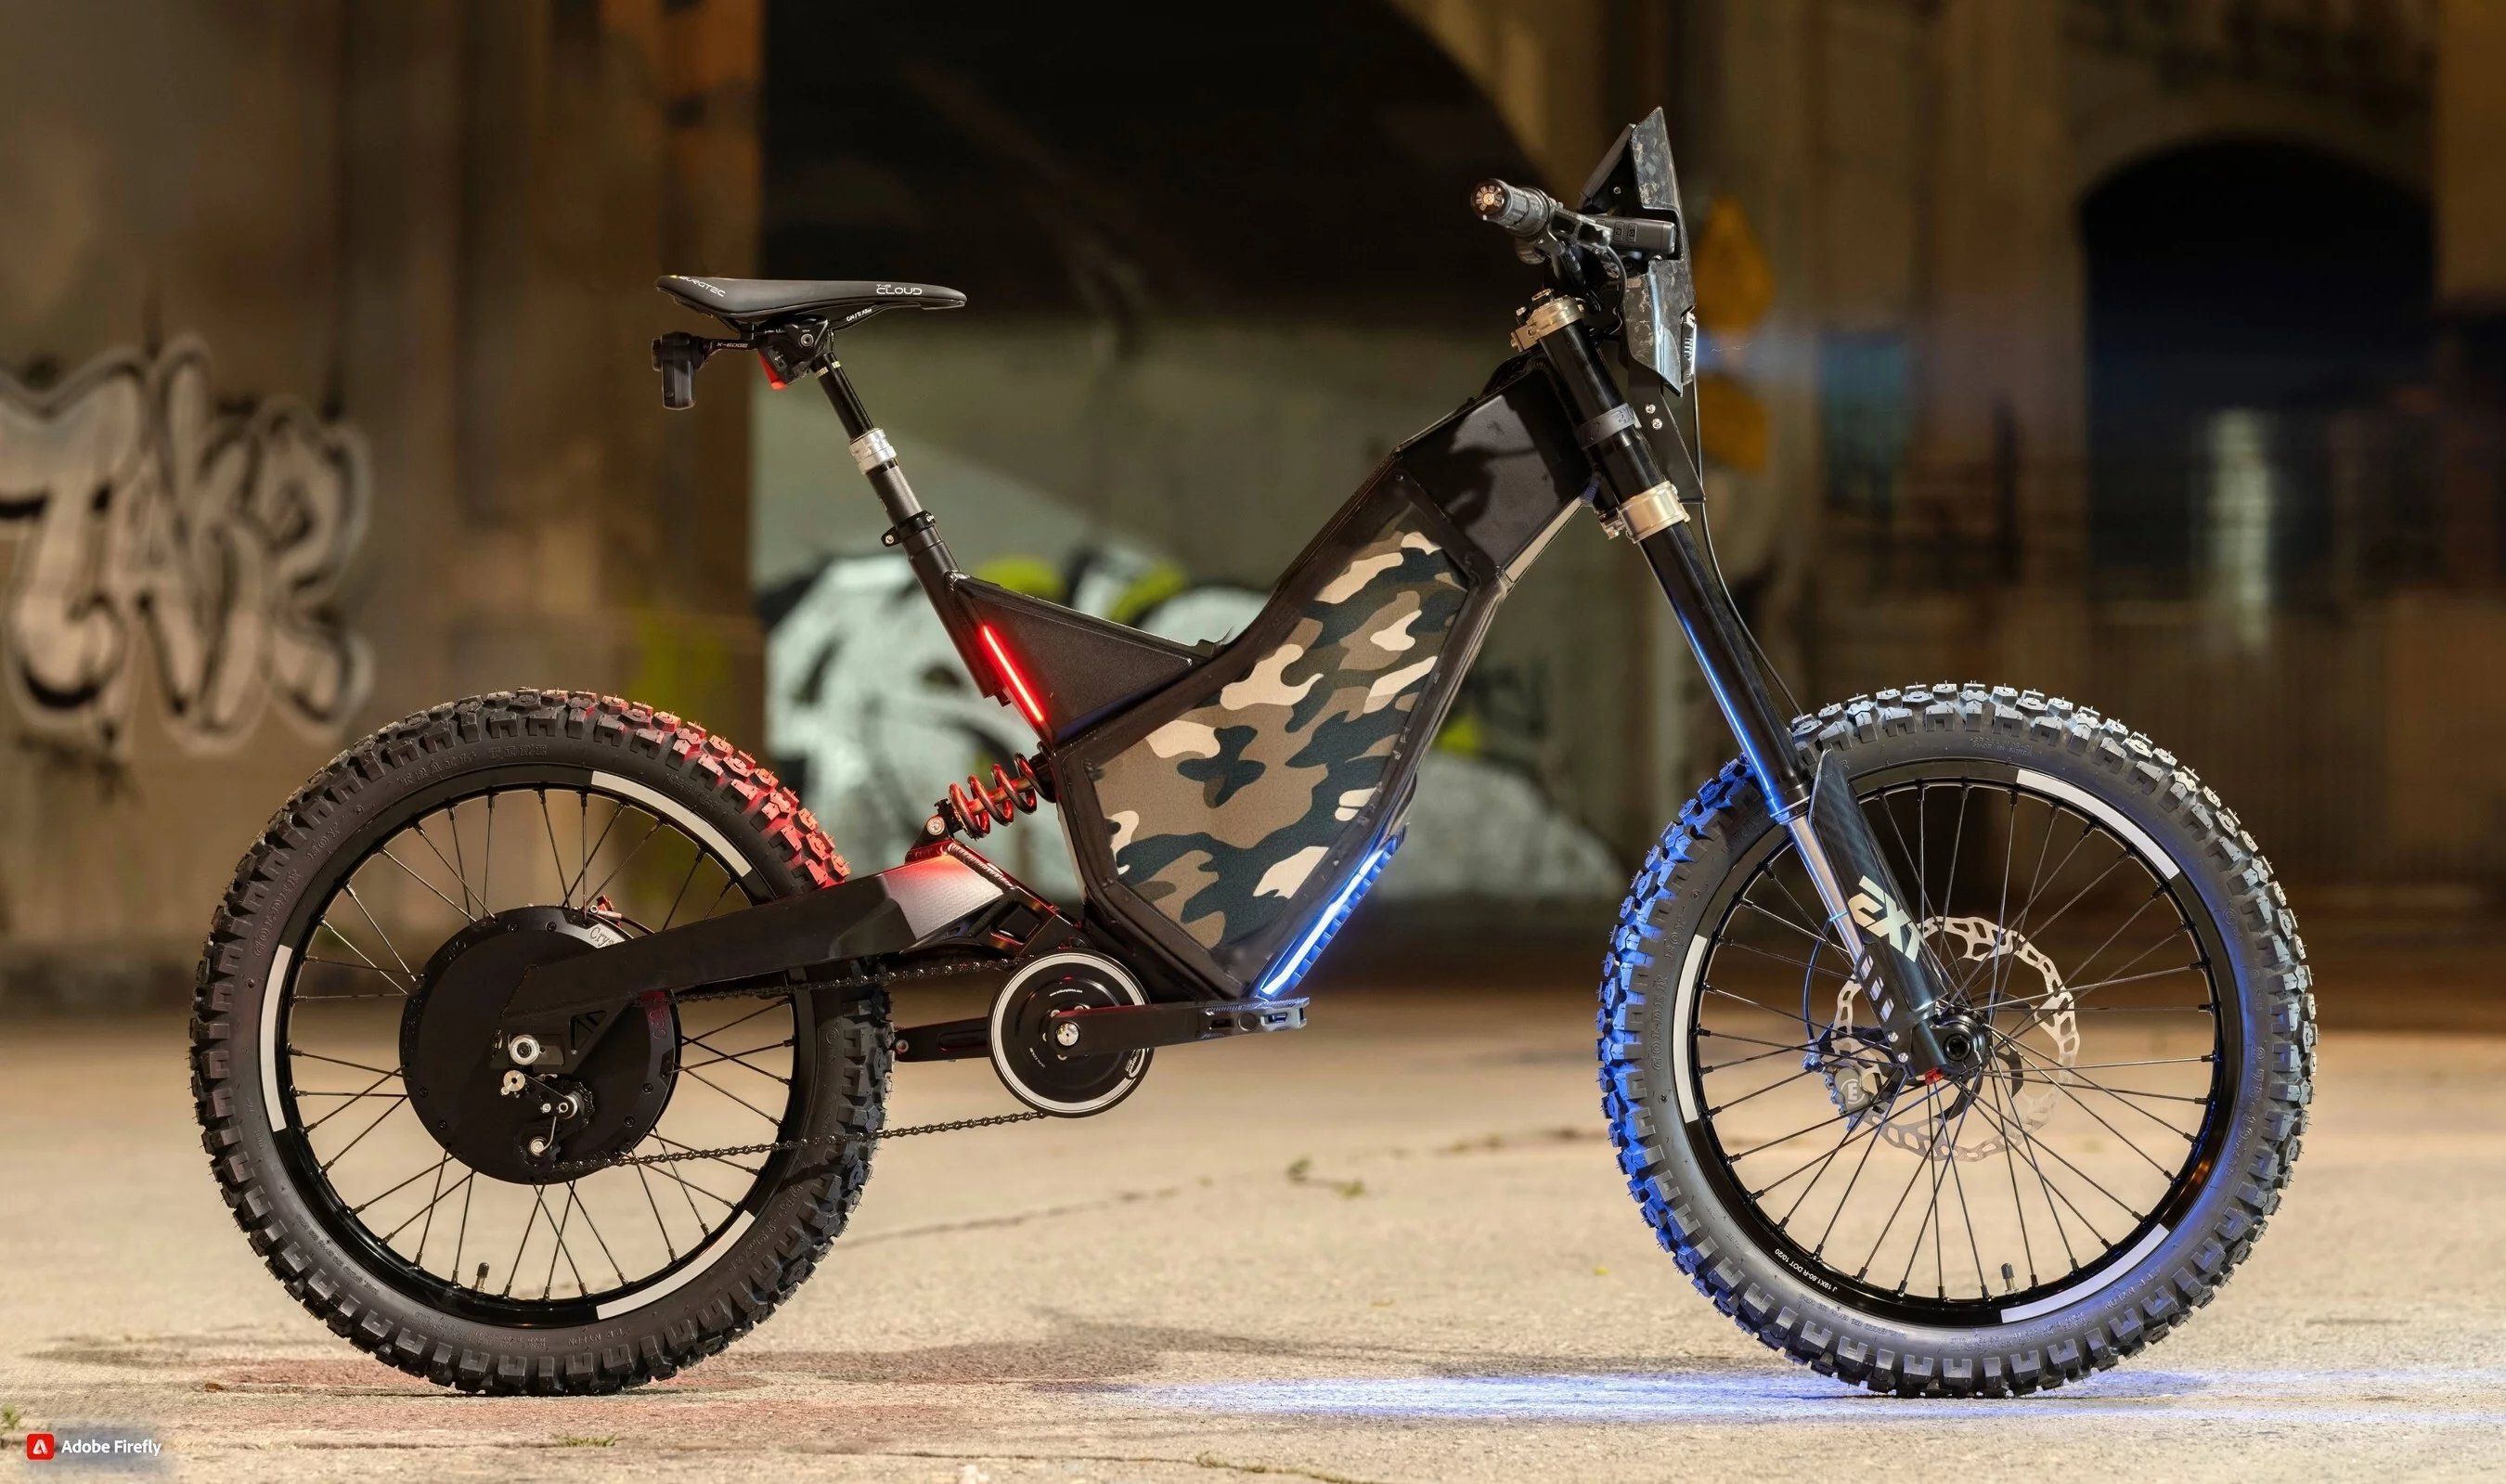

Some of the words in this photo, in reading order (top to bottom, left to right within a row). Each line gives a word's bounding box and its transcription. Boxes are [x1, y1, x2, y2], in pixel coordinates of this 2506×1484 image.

[876, 287, 923, 295] CLOUD
[1848, 875, 1923, 962] EXT
[1789, 1260, 1803, 1272] DOT
